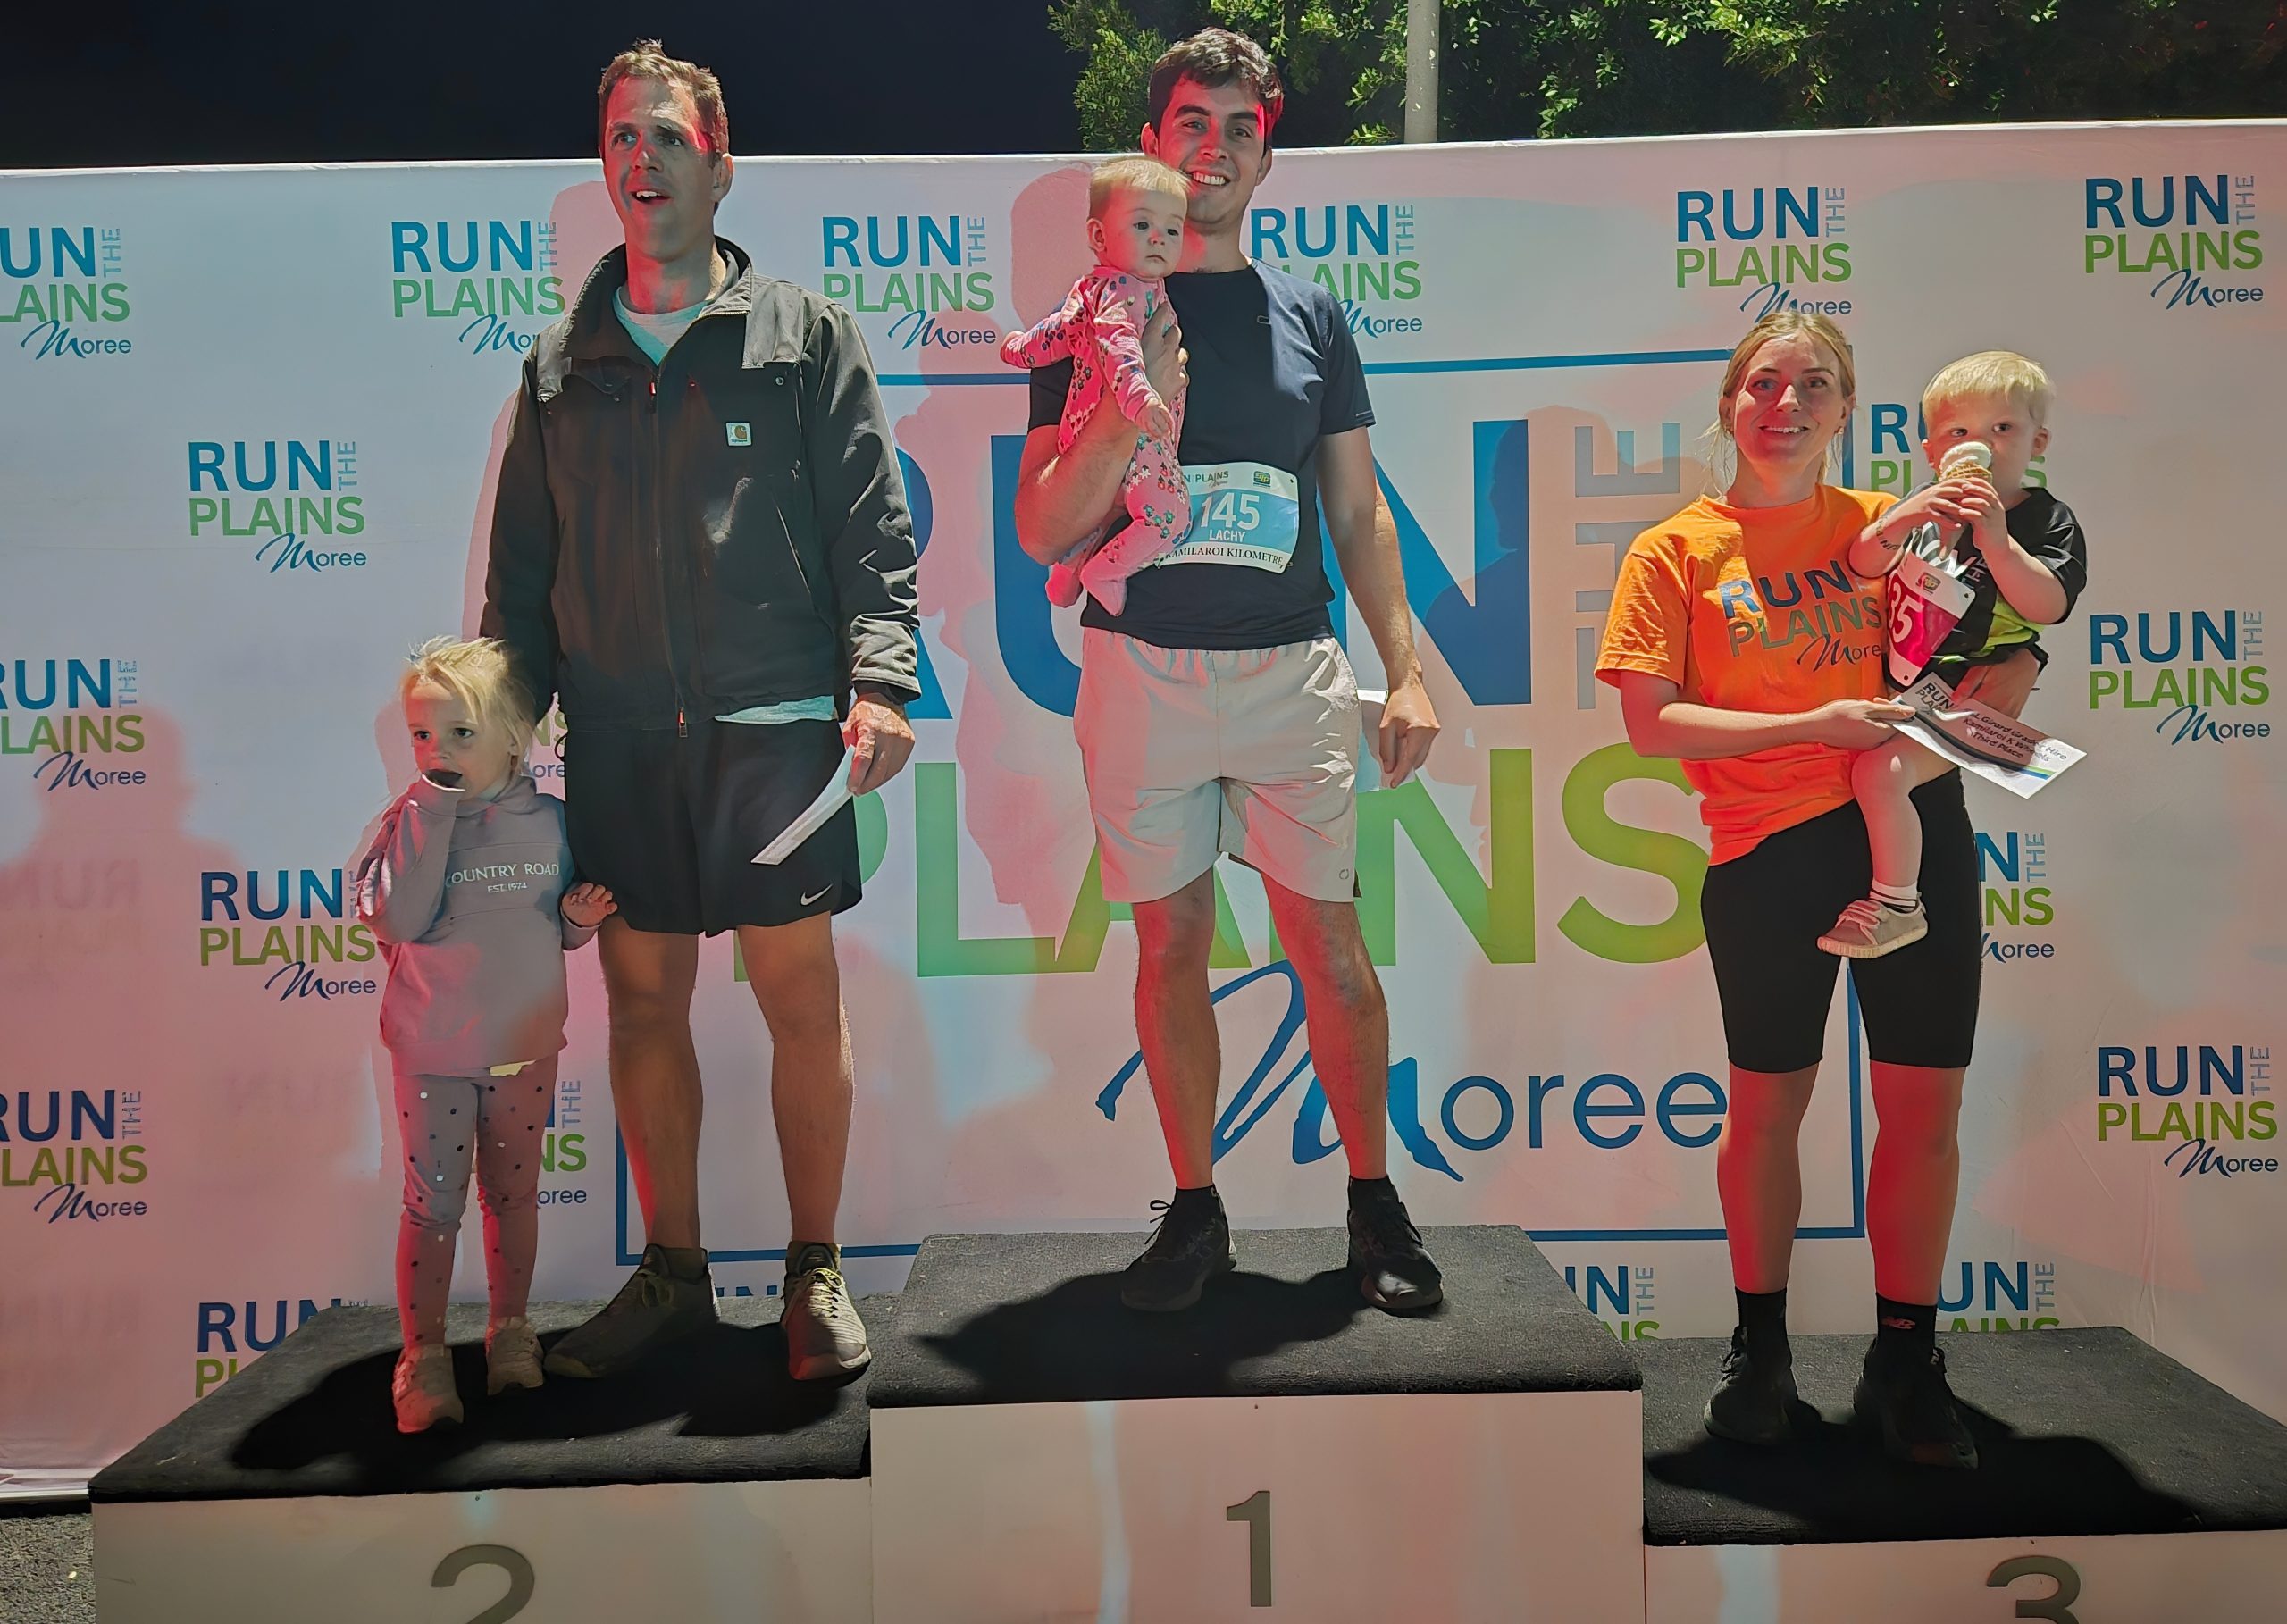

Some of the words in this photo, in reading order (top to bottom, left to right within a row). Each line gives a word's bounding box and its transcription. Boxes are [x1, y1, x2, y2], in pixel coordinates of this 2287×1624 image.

[1677, 187, 1819, 242] RUN
[1825, 187, 1846, 238] THE
[2085, 174, 2230, 229] RUN
[2235, 176, 2256, 225] THE
[391, 220, 532, 272] RUN
[538, 222, 557, 272] THE
[822, 215, 961, 267] RUN
[968, 216, 987, 267] THE
[1251, 204, 1389, 258] RUN
[1395, 205, 1414, 255] THE
[2085, 230, 2264, 273] PLAINS
[0, 227, 96, 278] UN
[101, 229, 121, 278] THE
[1676, 243, 1852, 288] PLAINS
[392, 276, 565, 317] PLAINS
[823, 272, 995, 313] PLAINS
[1282, 260, 1422, 302] AINS
[2150, 269, 2264, 310] Moree
[0, 283, 130, 322] AINS
[1739, 282, 1852, 323] Moree
[21, 320, 131, 360] Moree
[888, 309, 996, 351] Moree
[188, 441, 331, 492] RUN
[338, 441, 357, 490] THE
[1195, 470, 1229, 483] PLAINS
[188, 497, 365, 537] PLAINS
[1201, 492, 1260, 531] 145
[256, 532, 367, 573] Moree
[1209, 529, 1246, 542] LACHY
[1227, 548, 1284, 565] KILOMETRE
[1718, 559, 1854, 620] RUN
[1726, 596, 1883, 657] PLAINS
[2089, 610, 2237, 665] RUN
[2243, 611, 2264, 661] THE
[1796, 632, 1882, 673] More
[0, 659, 111, 710] UN
[1923, 682, 1955, 710] RUN
[2089, 666, 2270, 709] PLAINS
[1, 715, 145, 755] LAINS
[1973, 732, 1998, 747] Third
[1997, 743, 2023, 758] Place
[1981, 716, 2012, 732] Girard
[2045, 746, 2067, 760] Hire
[2156, 705, 2271, 746] Moree
[33, 751, 147, 791] Moree
[524, 862, 560, 876] ROAD
[2024, 832, 2047, 883] THE
[200, 869, 343, 921] RUN
[199, 925, 376, 966] PLAINS
[264, 960, 377, 1002] Moree
[1096, 958, 1727, 1181] Moree
[2098, 1045, 2244, 1097] RUN
[2250, 1046, 2271, 1096] THE
[561, 1080, 582, 1129] THE
[2098, 1101, 2278, 1141] PLAINS
[2, 1145, 148, 1187] LAINS
[2164, 1138, 2279, 1178] Moree
[34, 1183, 148, 1224] Moree
[536, 1188, 587, 1204] oree
[1635, 1267, 1655, 1317] THE
[1937, 1261, 2029, 1312] UN
[2035, 1262, 2055, 1312] THE
[1226, 1490, 1273, 1608] 1
[431, 1544, 536, 1624] 2
[1986, 1554, 2082, 1624] 3
